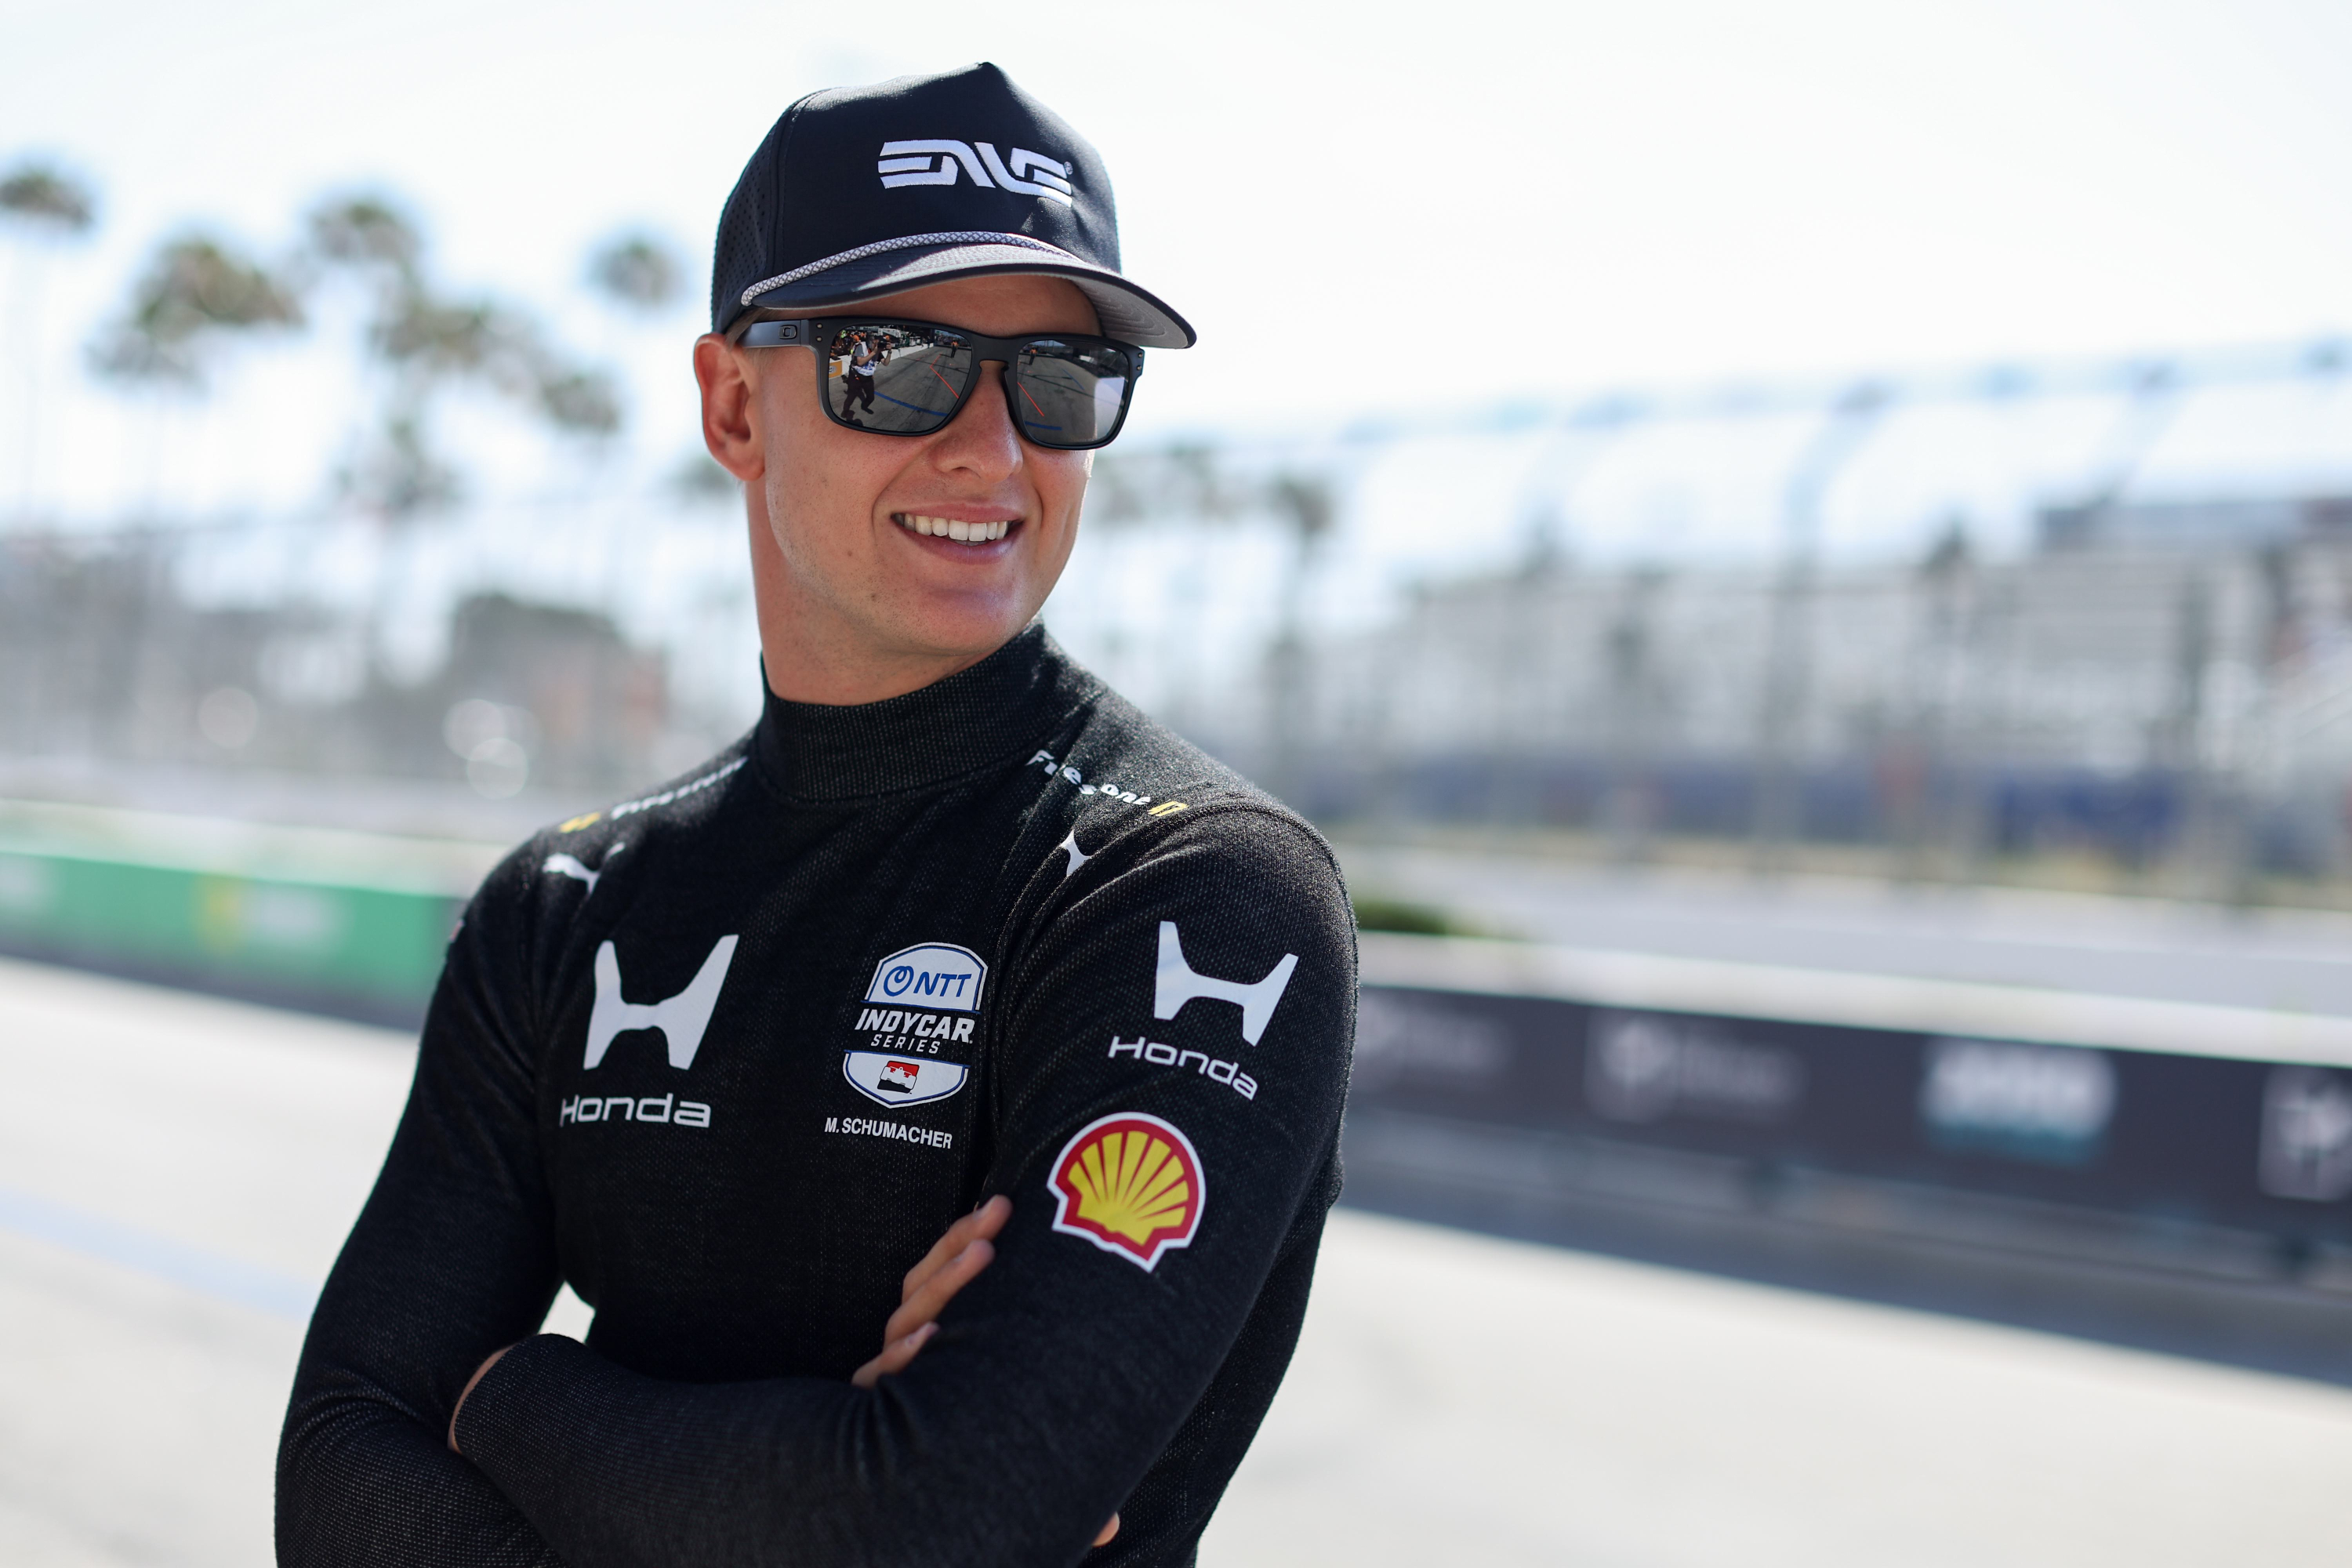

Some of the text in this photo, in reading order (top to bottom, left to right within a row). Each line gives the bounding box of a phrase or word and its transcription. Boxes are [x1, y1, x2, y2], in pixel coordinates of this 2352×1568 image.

[913, 971, 972, 998] NTT
[854, 1007, 975, 1044] INDYCAR
[870, 1033, 941, 1054] SERIES
[1108, 1036, 1258, 1101] Honda
[559, 1092, 711, 1128] Honda
